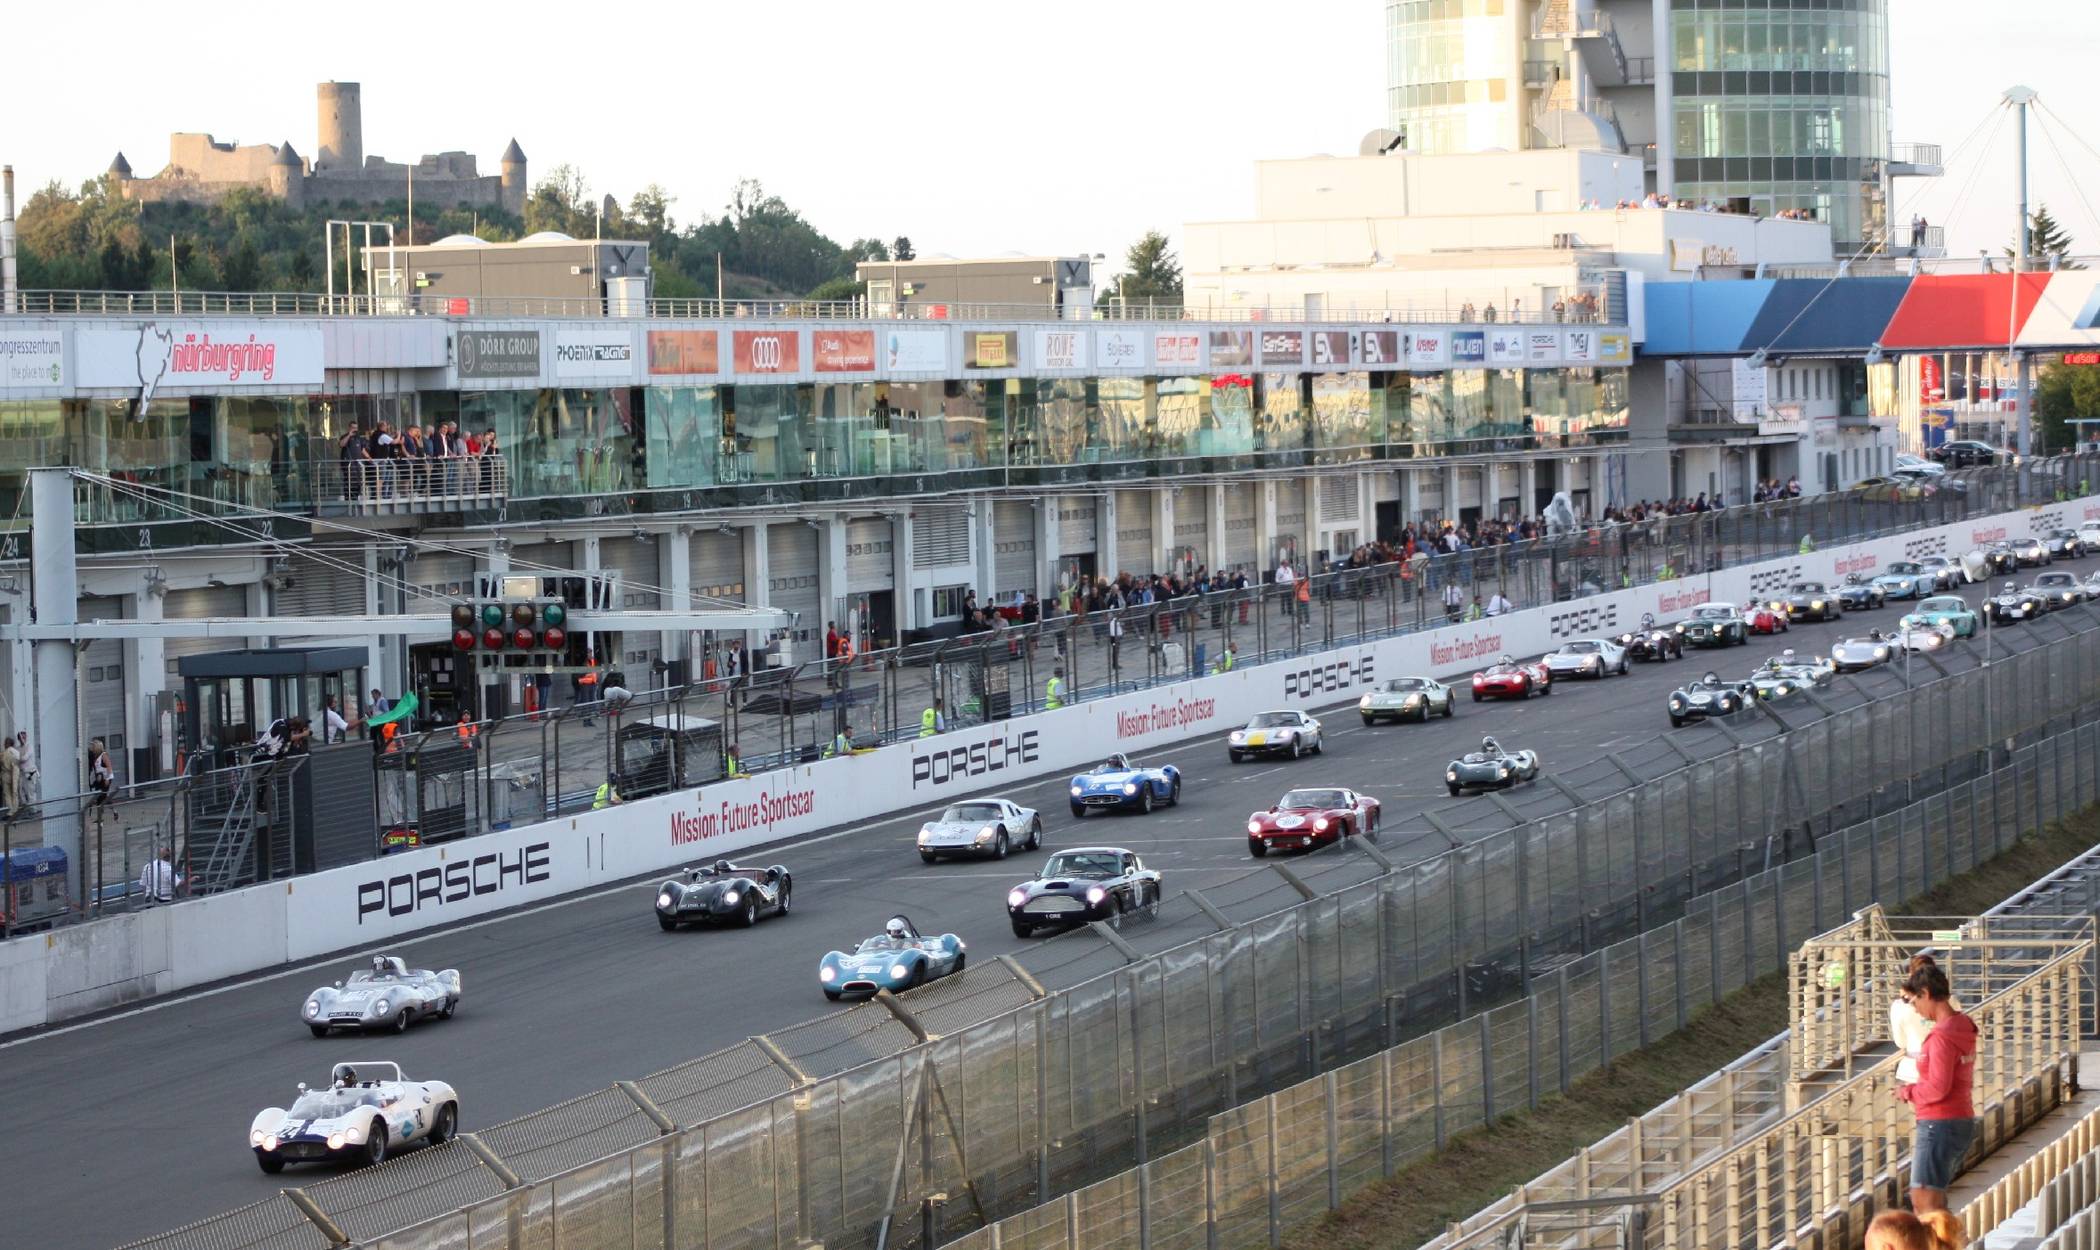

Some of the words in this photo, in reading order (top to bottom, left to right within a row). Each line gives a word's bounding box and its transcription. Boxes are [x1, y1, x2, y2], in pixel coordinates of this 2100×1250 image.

[172, 334, 275, 380] nürburgring
[480, 335, 505, 355] DÖRR
[508, 337, 538, 355] GROUP
[1046, 335, 1075, 356] ROWE
[499, 507, 507, 522] 21
[683, 493, 691, 509] 19
[139, 529, 150, 547] 23
[262, 520, 272, 537] 22
[6, 536, 19, 557] 24
[1551, 603, 1617, 639] PORSCHE
[1285, 656, 1374, 701] PORSCHE
[1117, 710, 1151, 739] Mission:
[1151, 704, 1177, 731] Future
[1178, 697, 1216, 730] Sportscar
[913, 730, 1039, 790] PORSCHE
[671, 811, 719, 846] Mission:
[722, 801, 758, 834] Future
[760, 789, 815, 832] Sportscar
[357, 842, 550, 925] PORSCHE
